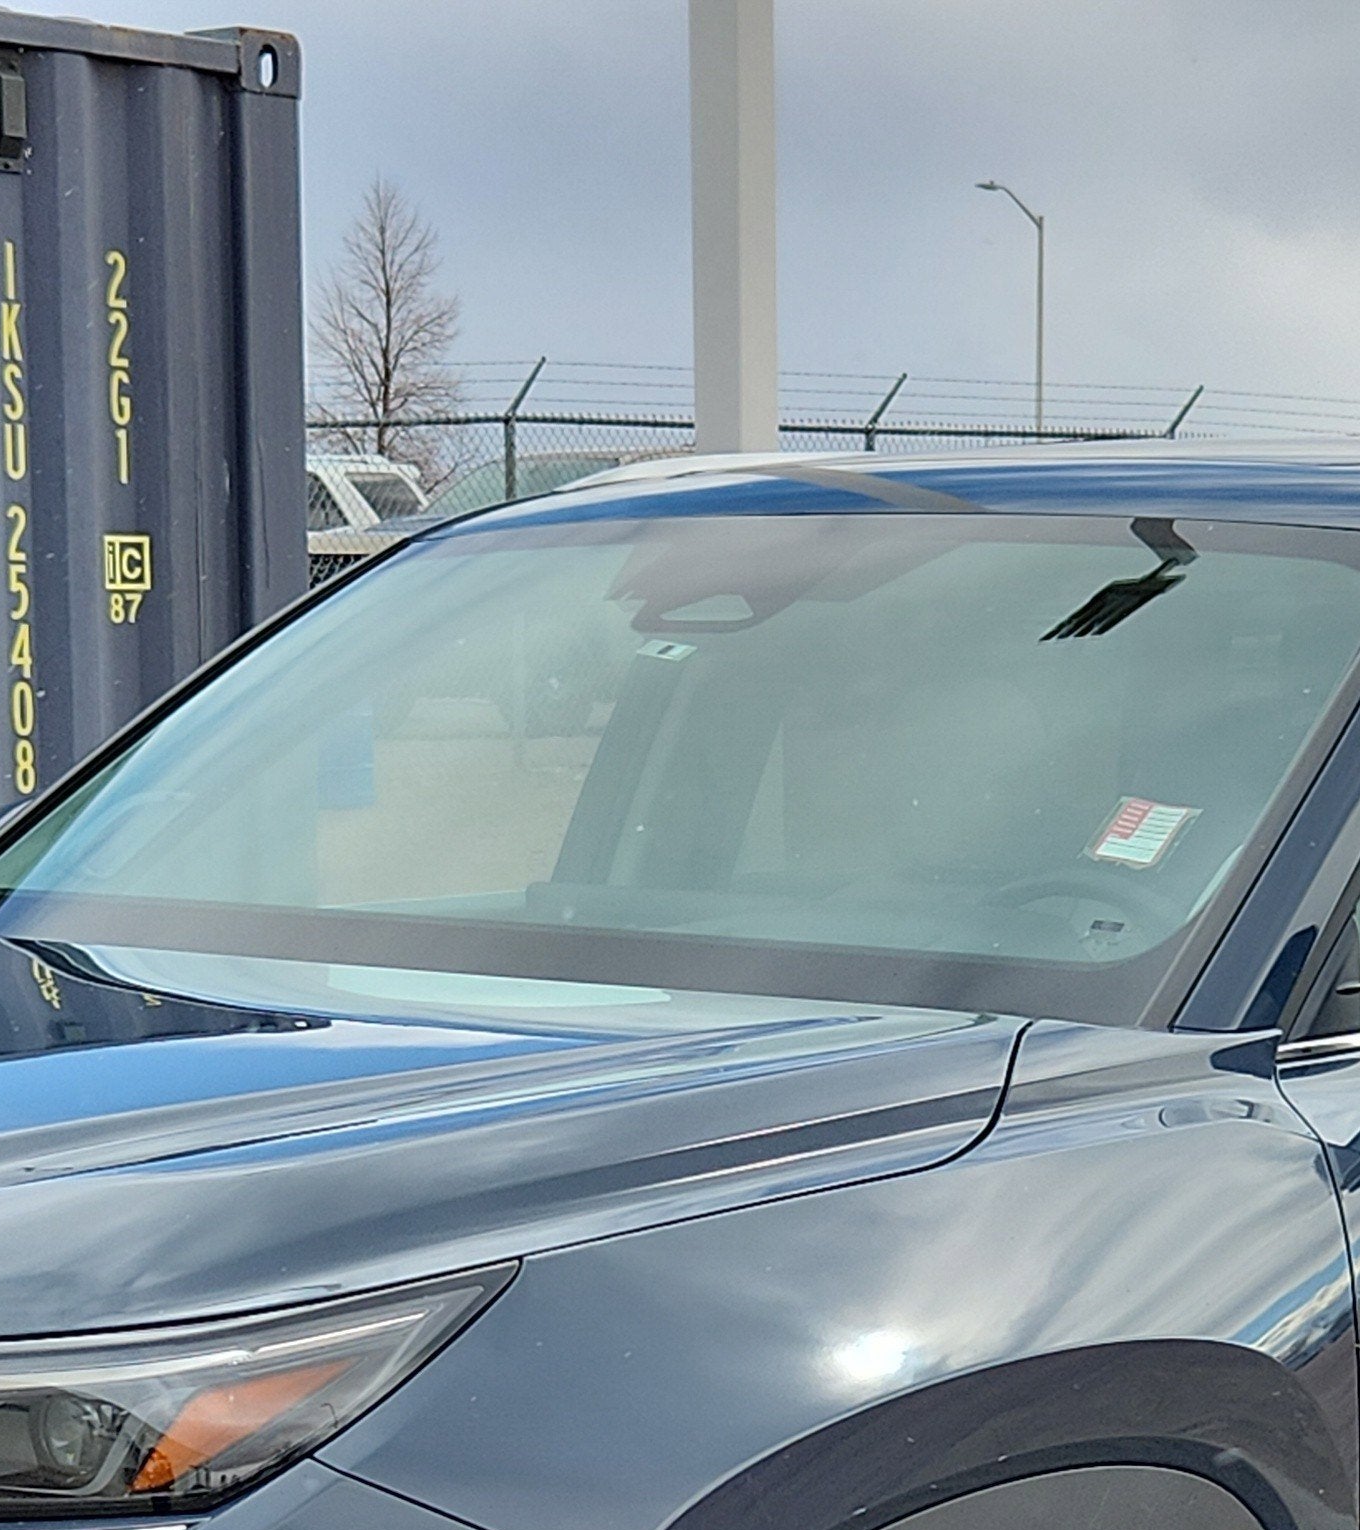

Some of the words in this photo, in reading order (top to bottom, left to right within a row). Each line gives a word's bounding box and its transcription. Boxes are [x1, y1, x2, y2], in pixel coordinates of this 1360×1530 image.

[1, 240, 27, 481] IKSU
[105, 250, 133, 485] 22G1
[6, 505, 37, 795] 25408
[110, 593, 143, 624] 87
